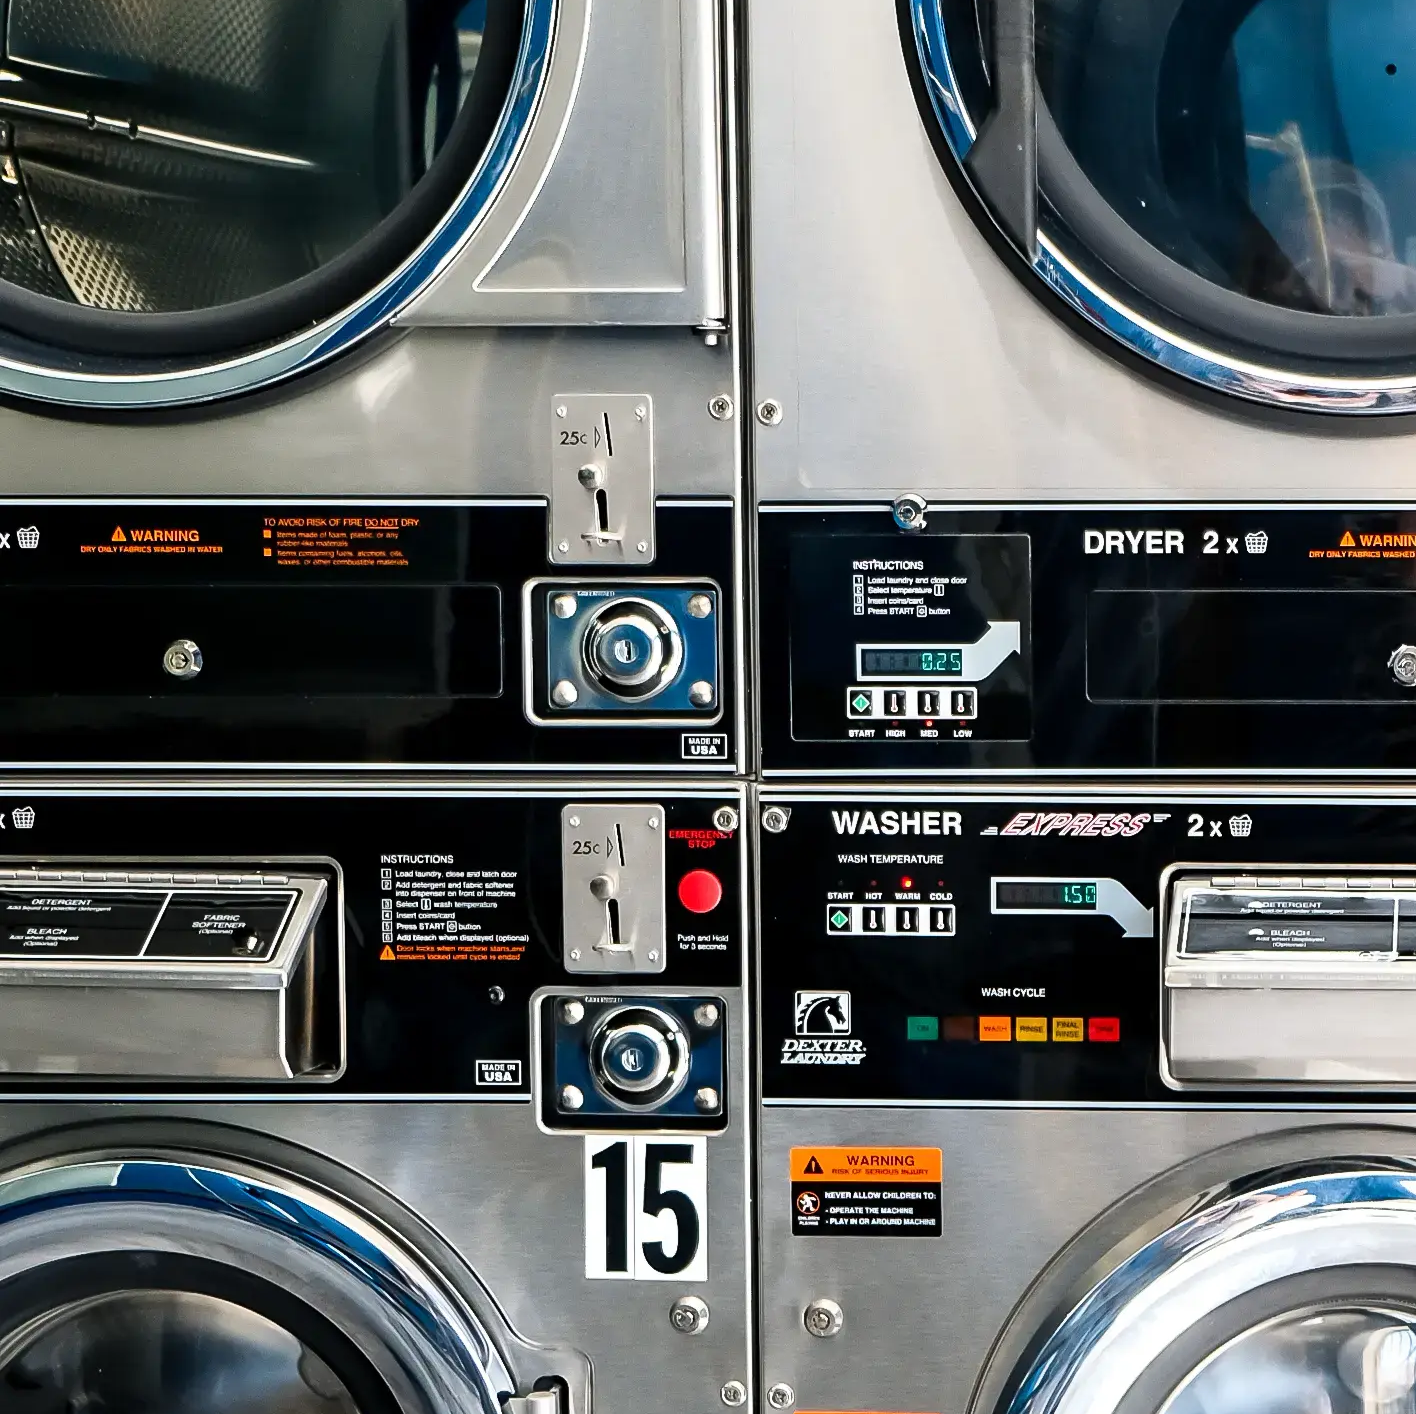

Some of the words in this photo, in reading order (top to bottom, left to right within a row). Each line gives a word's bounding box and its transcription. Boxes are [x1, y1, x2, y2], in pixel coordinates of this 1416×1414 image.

[131, 530, 199, 542] WARNING
[1084, 530, 1184, 555] DRYER
[1204, 532, 1220, 555] 2
[853, 560, 923, 570] INSTRUCTIONS
[688, 737, 711, 745] MADE
[713, 737, 720, 745] IN
[691, 745, 717, 755] USA
[832, 811, 962, 835] WASHER
[1000, 813, 1151, 836] EXPRESS
[1188, 814, 1203, 837] 2
[688, 840, 715, 848] STOP
[381, 855, 453, 863] INSTRUCTIONS
[838, 855, 867, 863] WASH
[870, 855, 943, 864] TEMPERATURE
[828, 892, 853, 900] START
[866, 892, 882, 900] HOT
[895, 892, 920, 900] WARM
[930, 892, 952, 900] COLD
[982, 988, 1010, 997] WASH
[1013, 988, 1045, 997] CYCLE
[782, 1039, 864, 1052] DEXTER
[781, 1052, 866, 1064] LAUNDRY
[485, 1071, 512, 1083] USA
[847, 1156, 915, 1166] WARNING
[591, 1141, 699, 1274] 15
